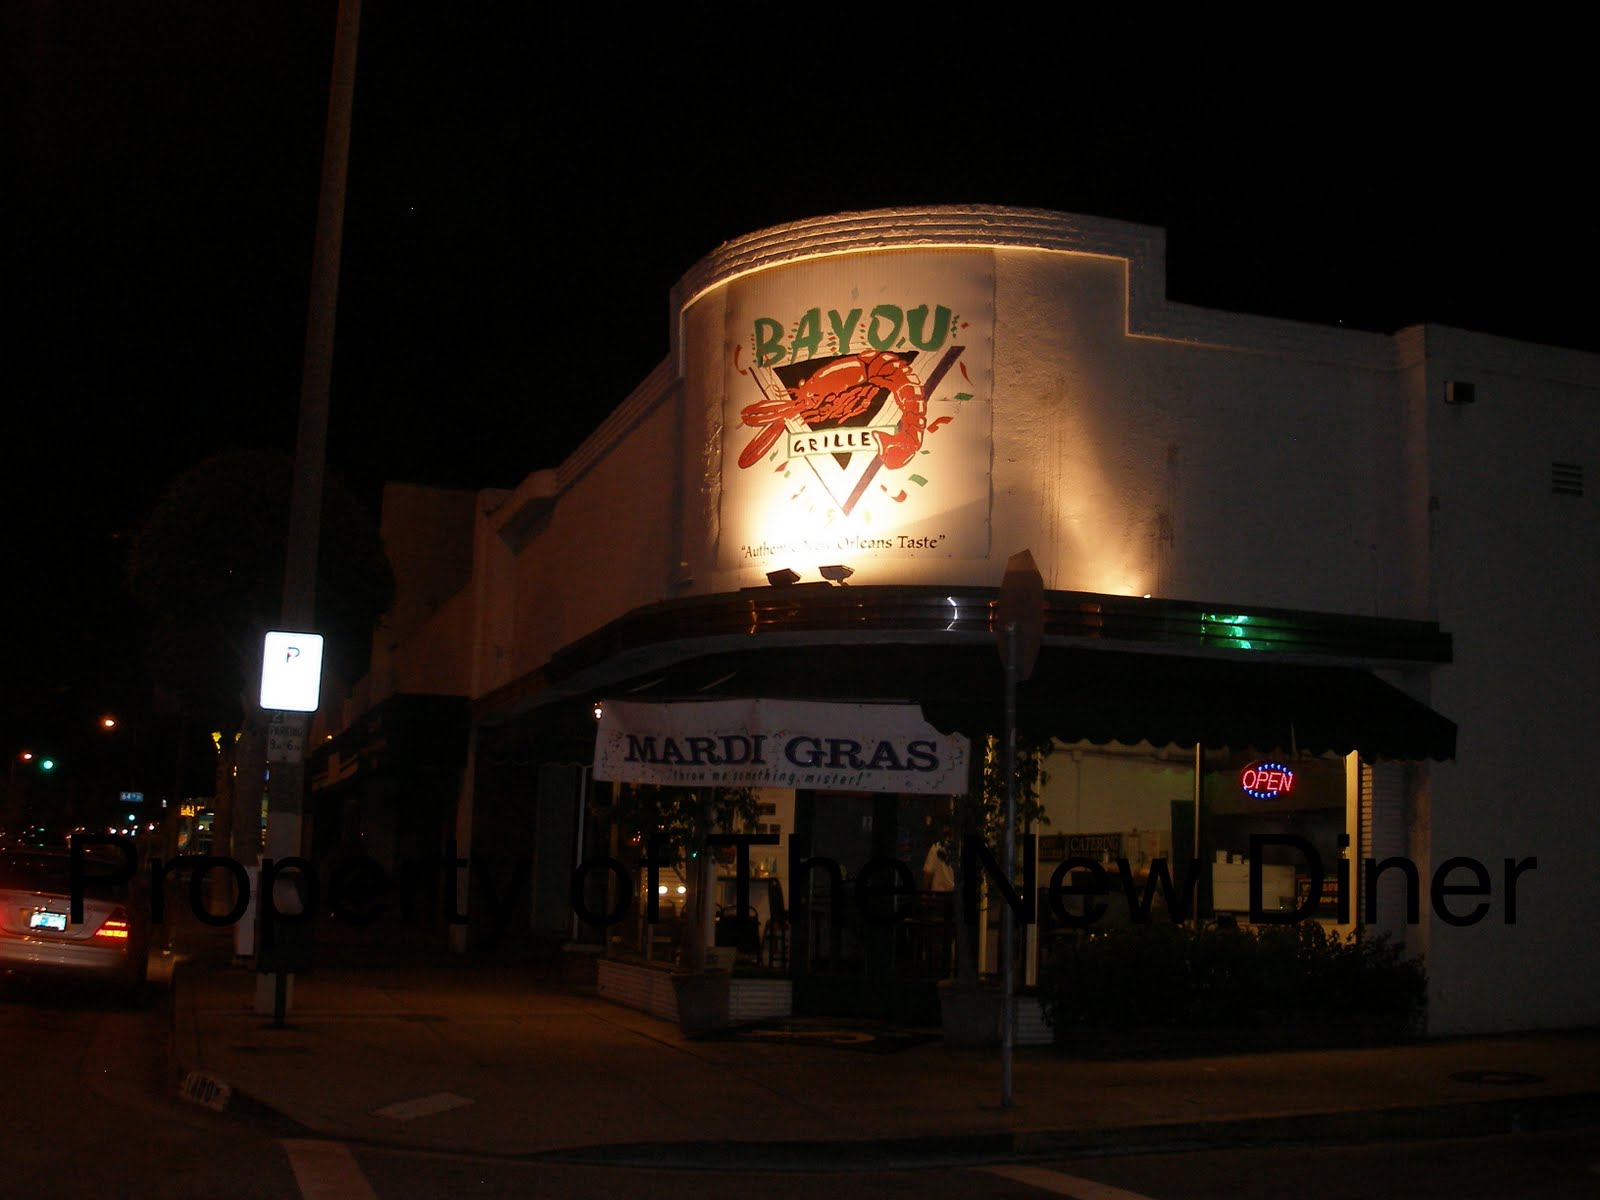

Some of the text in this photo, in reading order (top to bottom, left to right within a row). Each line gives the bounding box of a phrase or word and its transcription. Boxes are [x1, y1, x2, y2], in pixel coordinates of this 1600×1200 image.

[753, 304, 952, 367] BAYOU
[793, 431, 871, 454] GRILLE
[837, 536, 893, 550] Orleans
[897, 534, 946, 550] Taste"
[285, 646, 301, 663] P
[624, 734, 939, 773] MARDI GRAS
[1242, 769, 1294, 792] OPEN
[1070, 834, 1121, 851] CATERING
